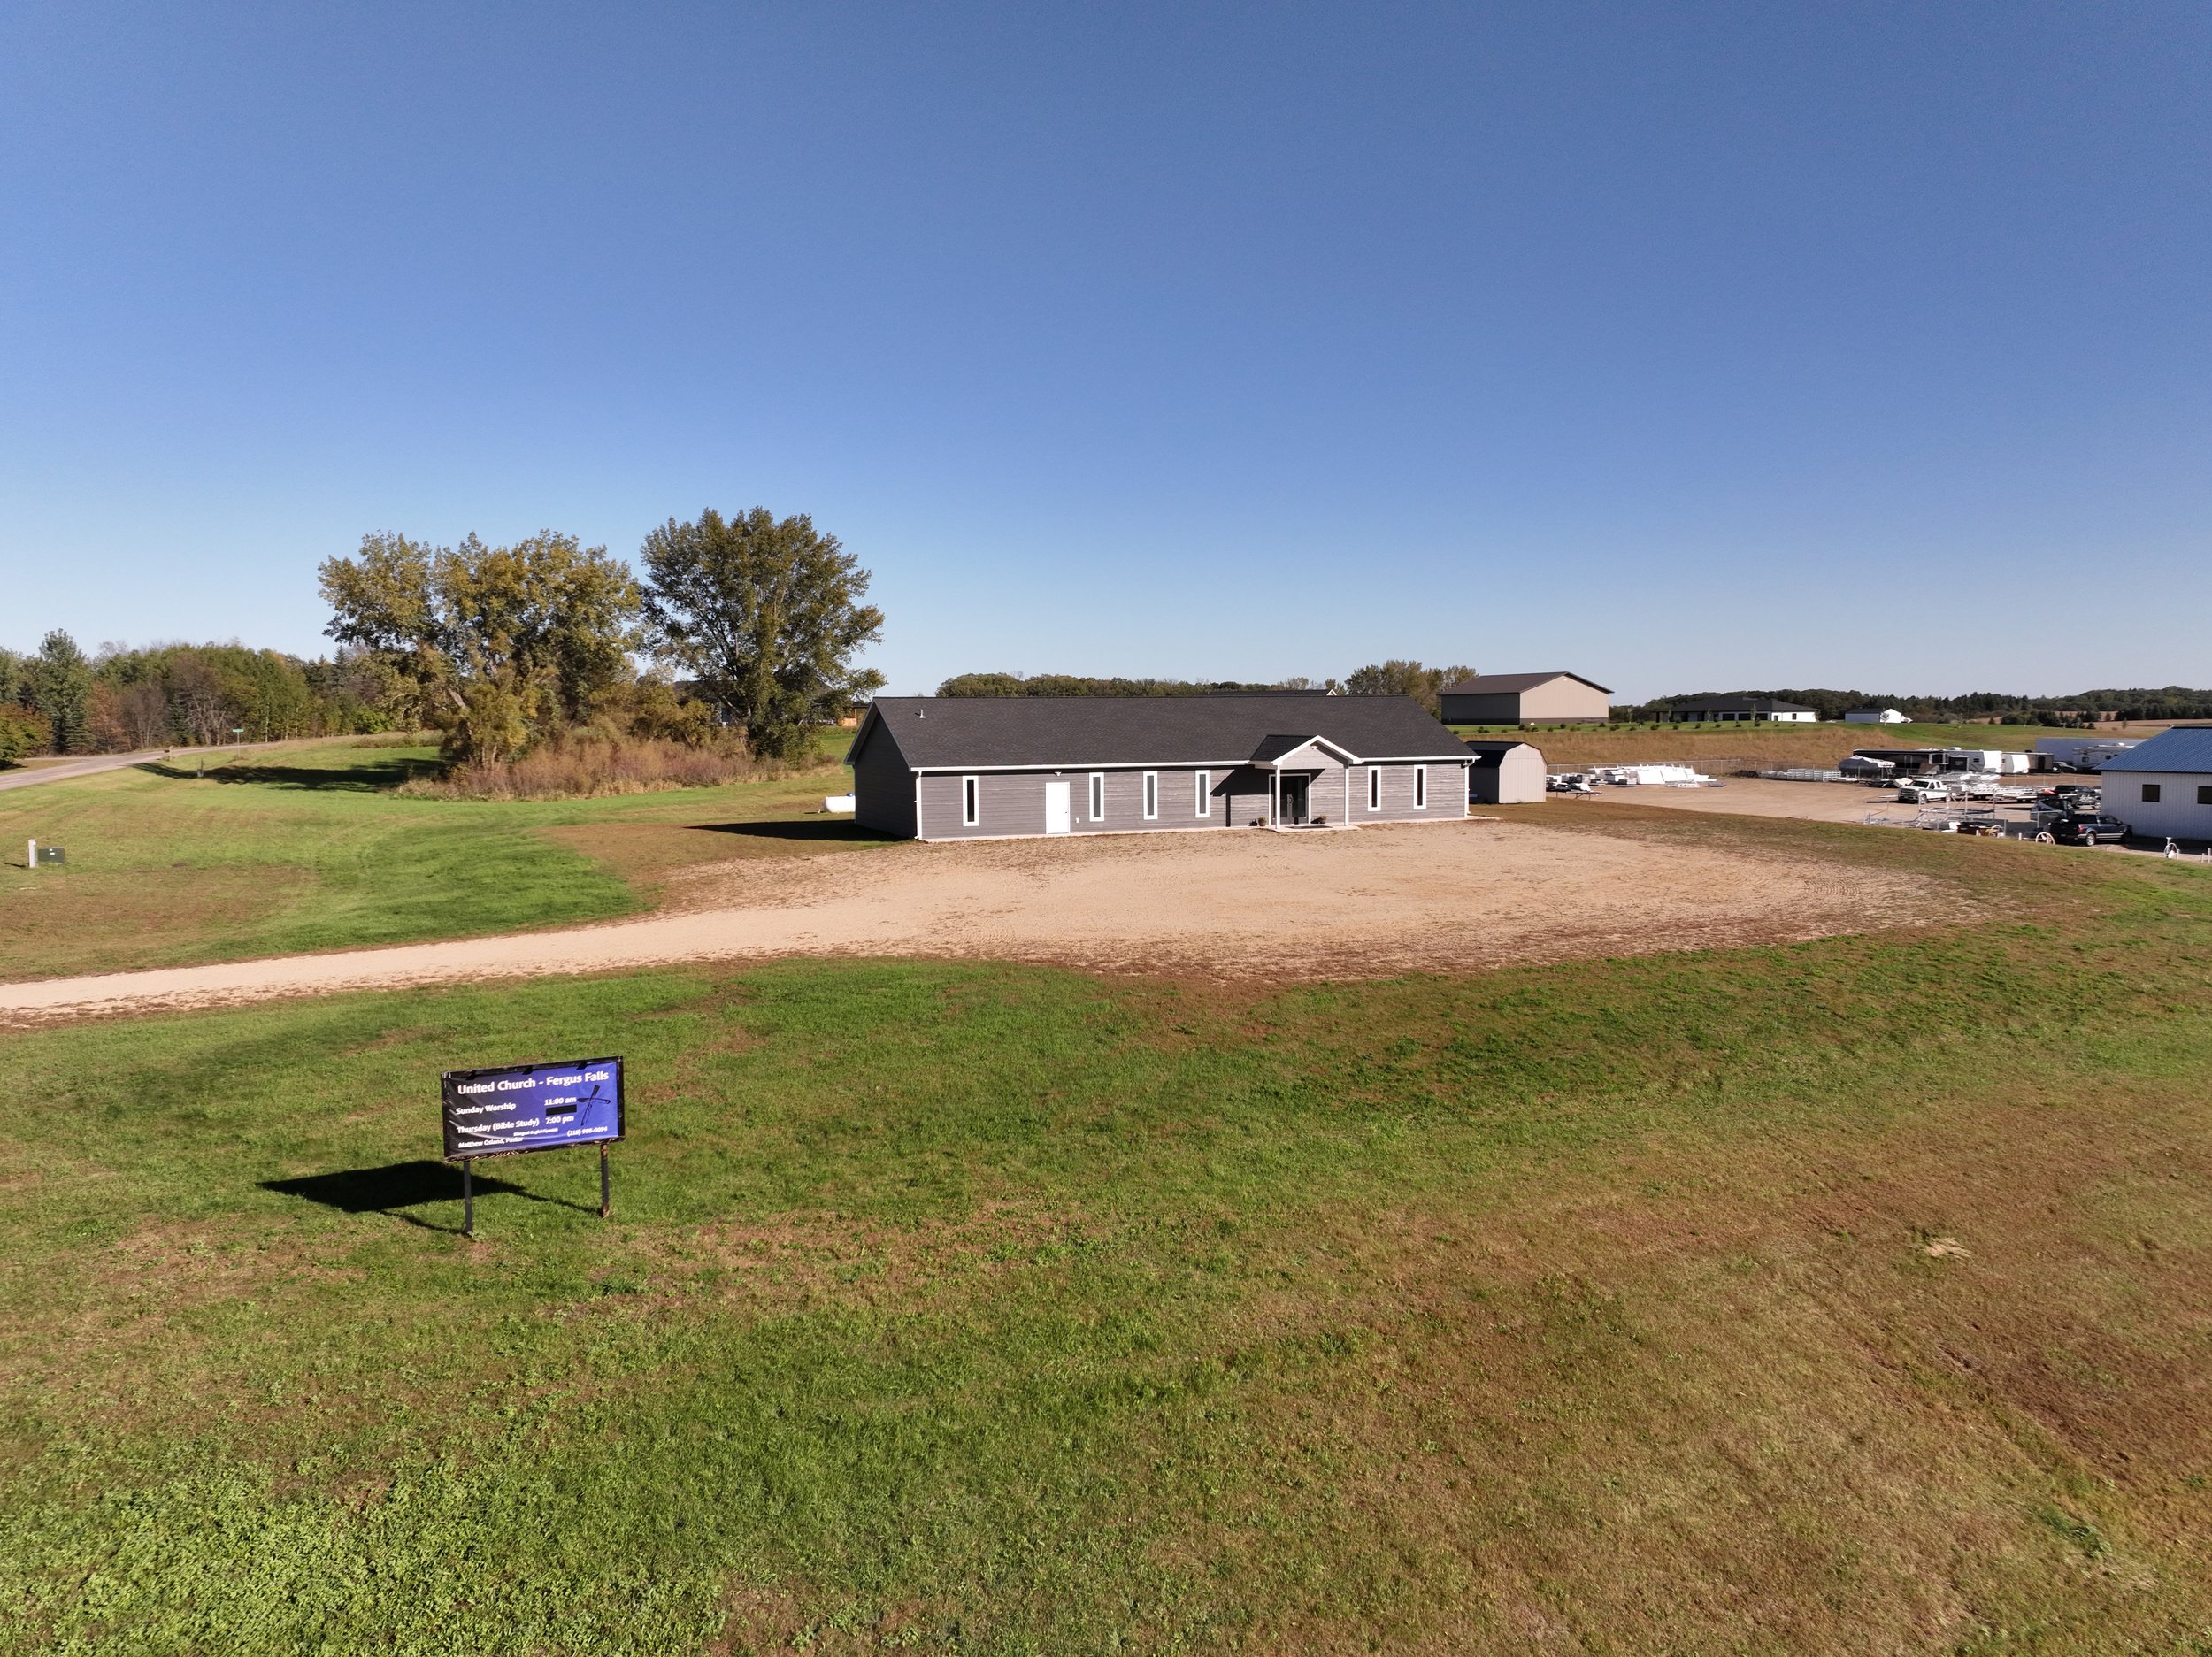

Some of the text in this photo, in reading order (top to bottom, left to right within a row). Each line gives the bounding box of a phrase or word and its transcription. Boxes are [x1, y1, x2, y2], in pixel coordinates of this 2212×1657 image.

[457, 1081, 495, 1094] United
[497, 1078, 536, 1091] Church
[546, 1075, 582, 1086] Fergus
[584, 1070, 609, 1082] Falls
[455, 1102, 517, 1115] Sunday Worship
[544, 1097, 564, 1106] 11:00
[457, 1117, 540, 1133] Thursday (Bible Study)
